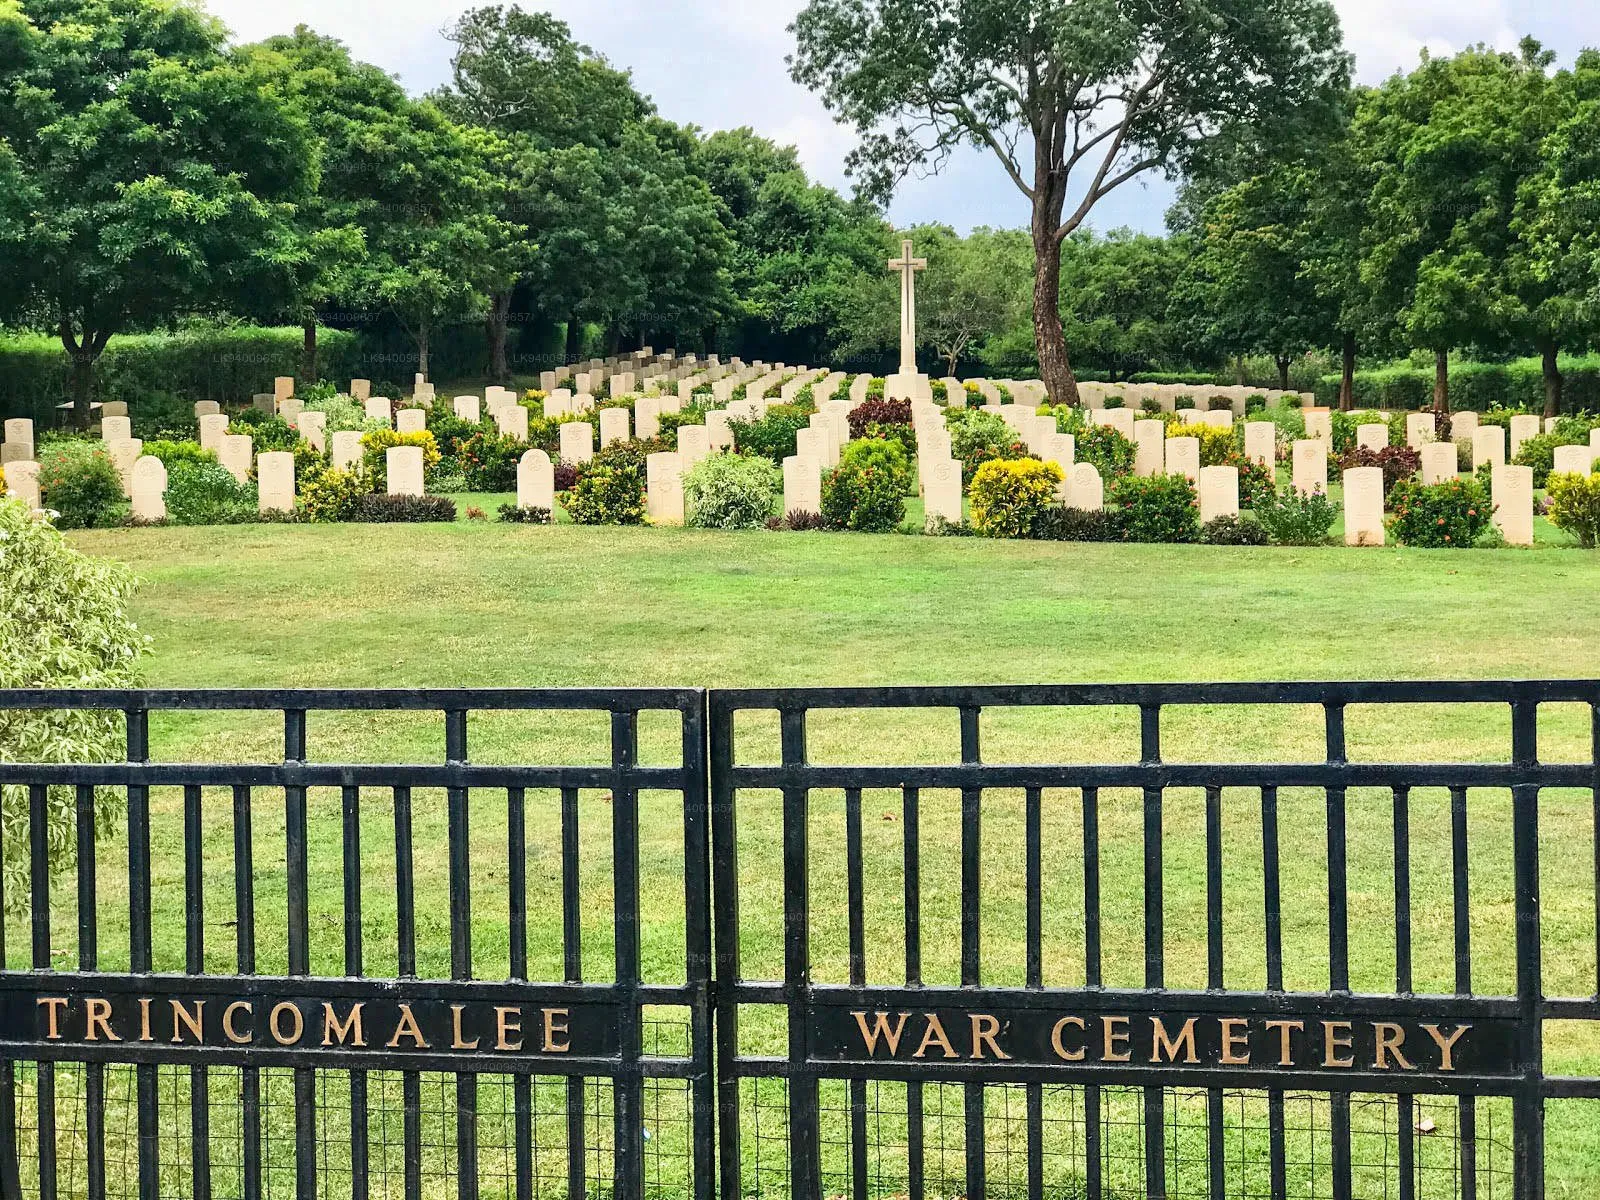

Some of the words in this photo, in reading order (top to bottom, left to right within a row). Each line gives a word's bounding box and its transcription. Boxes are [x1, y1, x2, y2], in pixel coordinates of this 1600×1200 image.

[36, 996, 571, 1054] TRINCOMALEE
[850, 1010, 1012, 1062] WAR
[1050, 1016, 1473, 1073] CEMETERY
